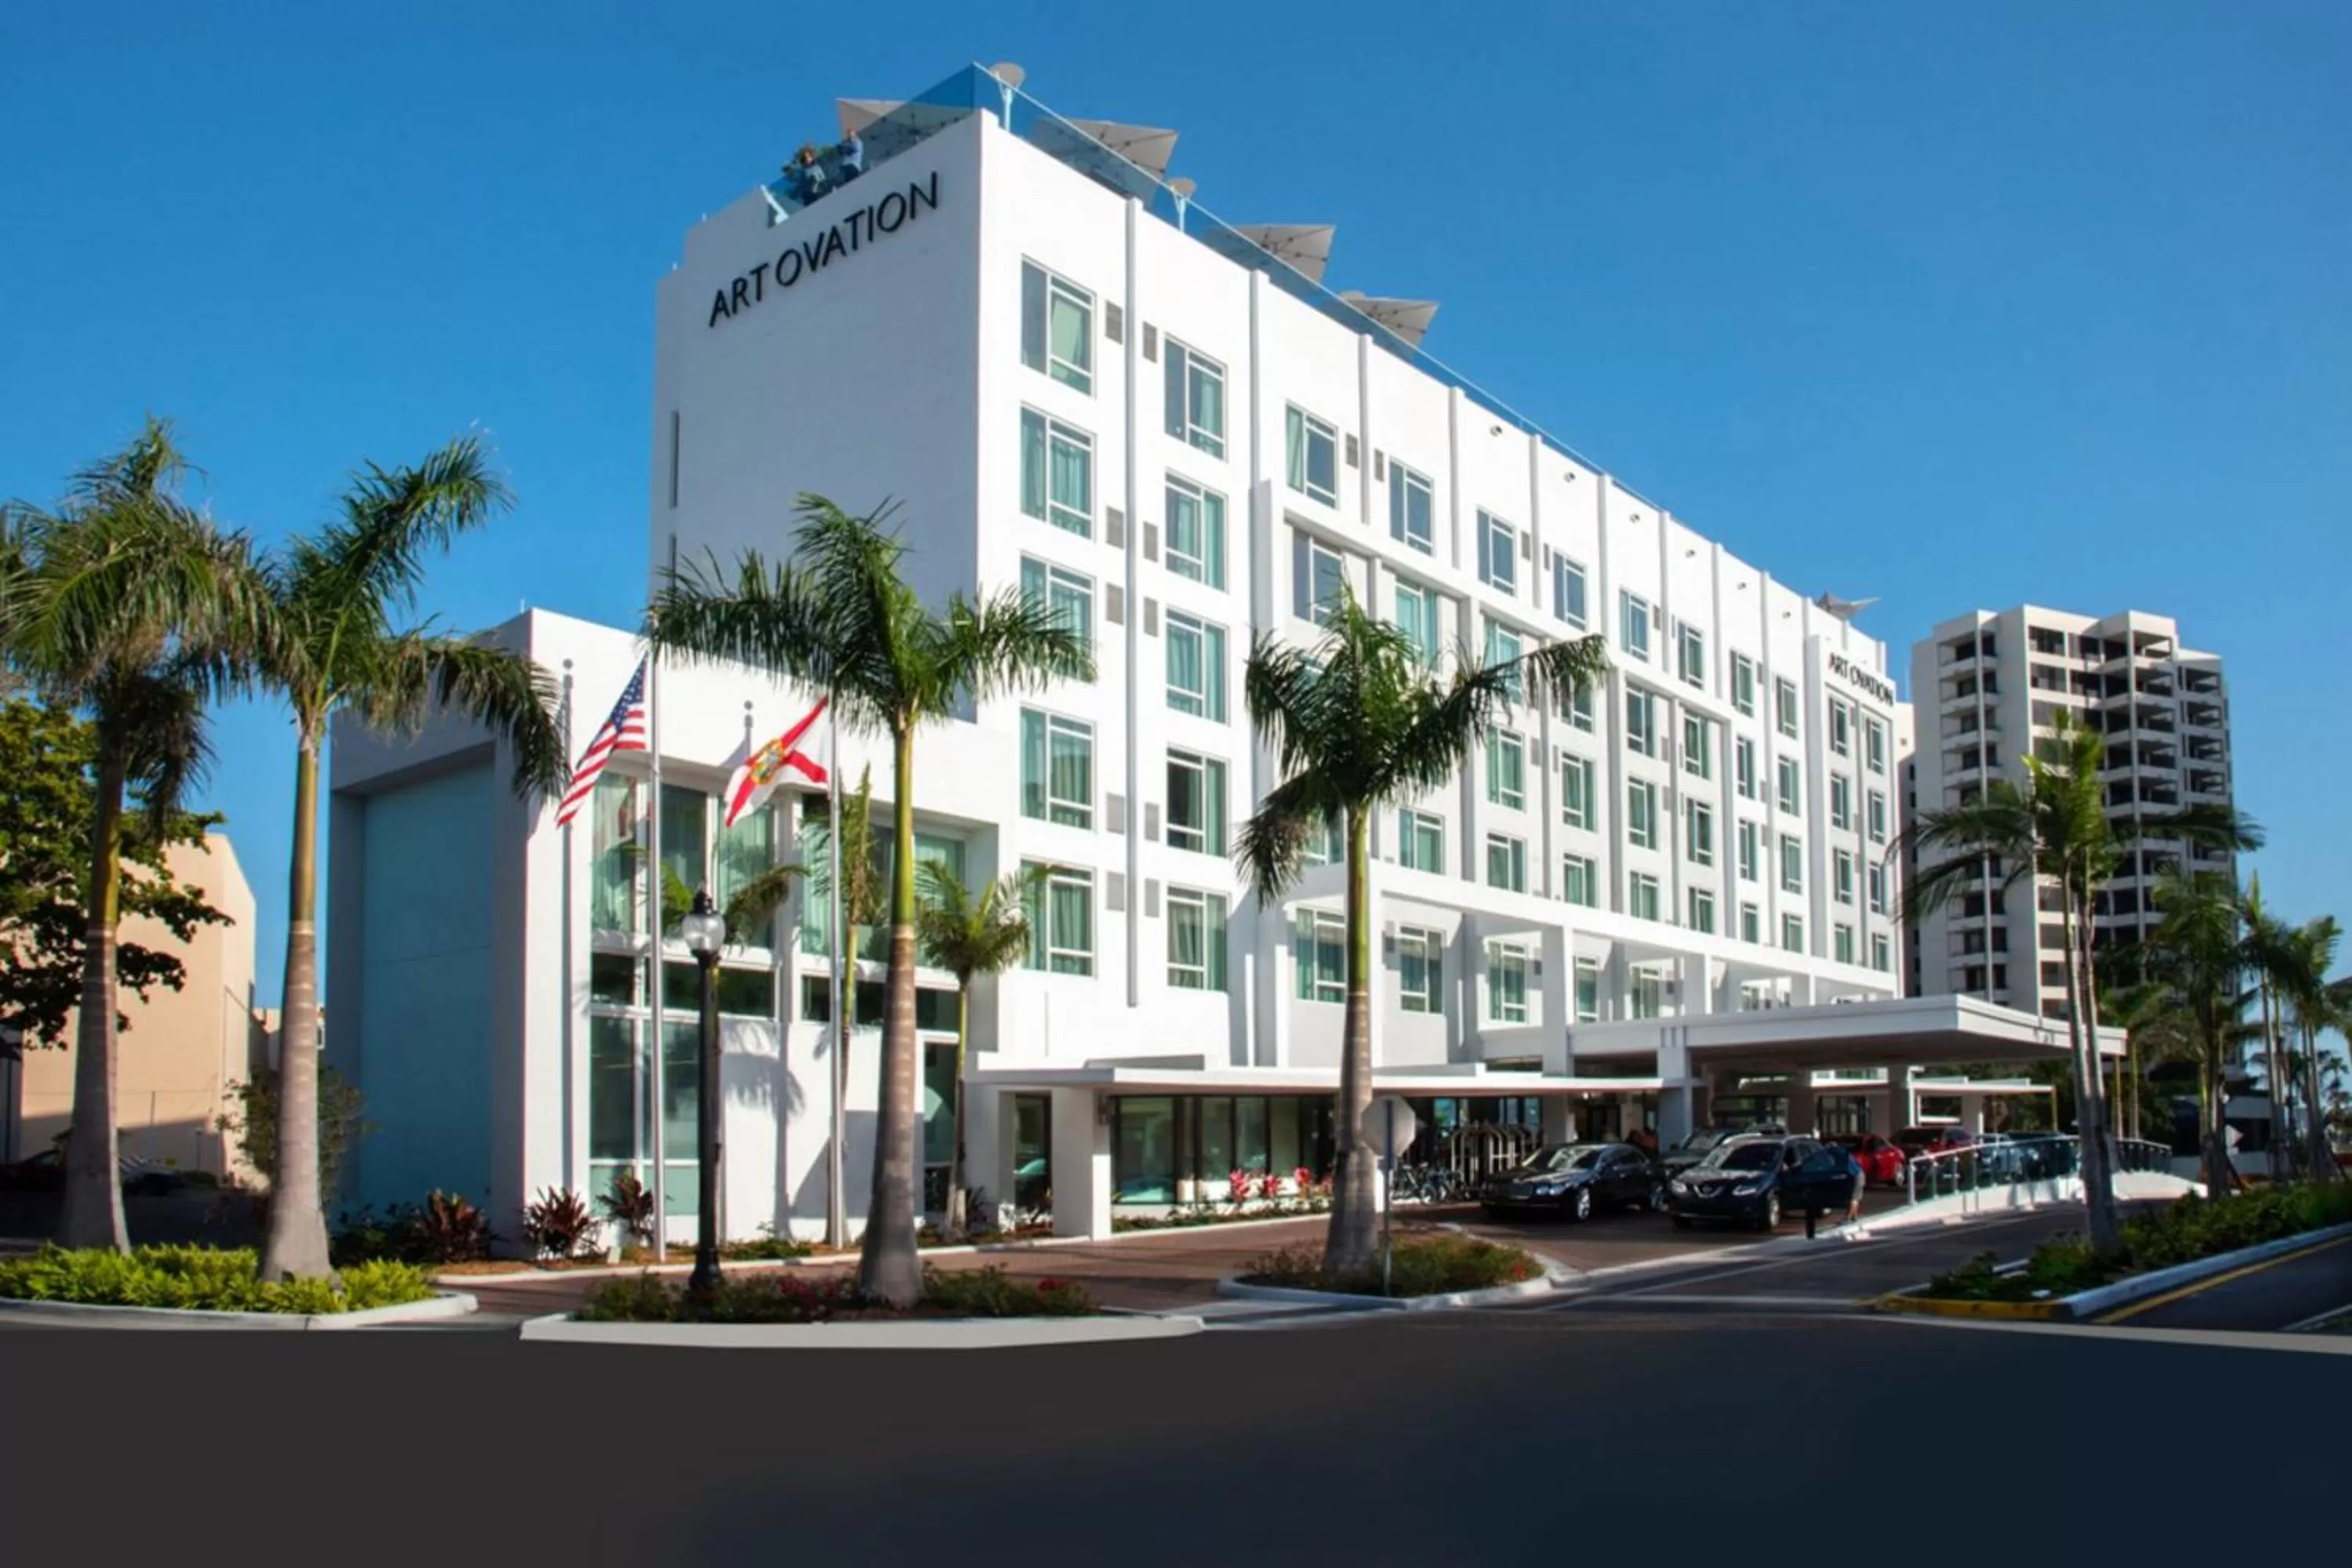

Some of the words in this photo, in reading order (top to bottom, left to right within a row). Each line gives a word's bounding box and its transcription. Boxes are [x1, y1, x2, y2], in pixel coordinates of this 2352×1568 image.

[709, 262, 769, 328] ART
[775, 170, 938, 287] OVATION
[1829, 652, 1849, 678] ART
